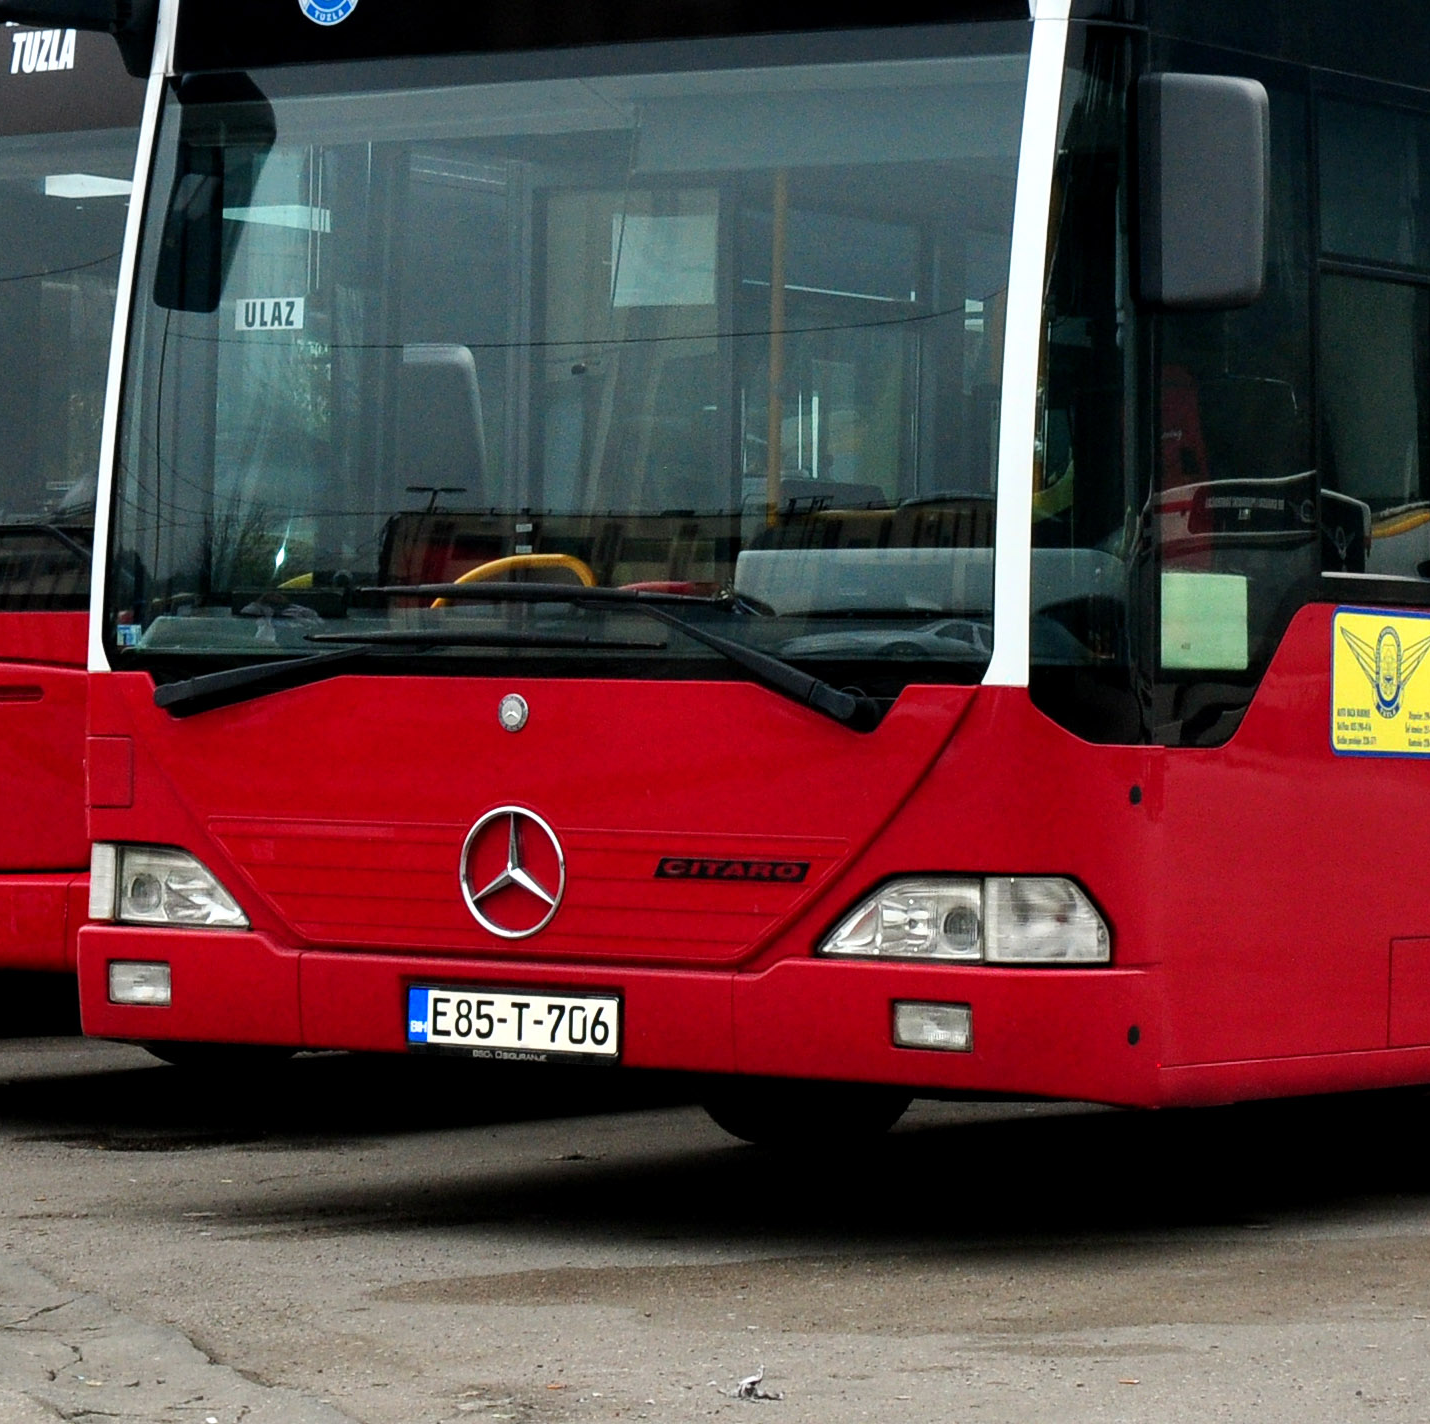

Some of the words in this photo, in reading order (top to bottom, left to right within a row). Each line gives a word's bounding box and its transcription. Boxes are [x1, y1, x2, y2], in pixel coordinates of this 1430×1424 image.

[314, 10, 344, 22] TUZLA
[11, 29, 77, 74] TUZLA
[244, 301, 295, 328] ULAZ
[663, 860, 802, 878] CITARO
[432, 997, 610, 1046] E85-T-706
